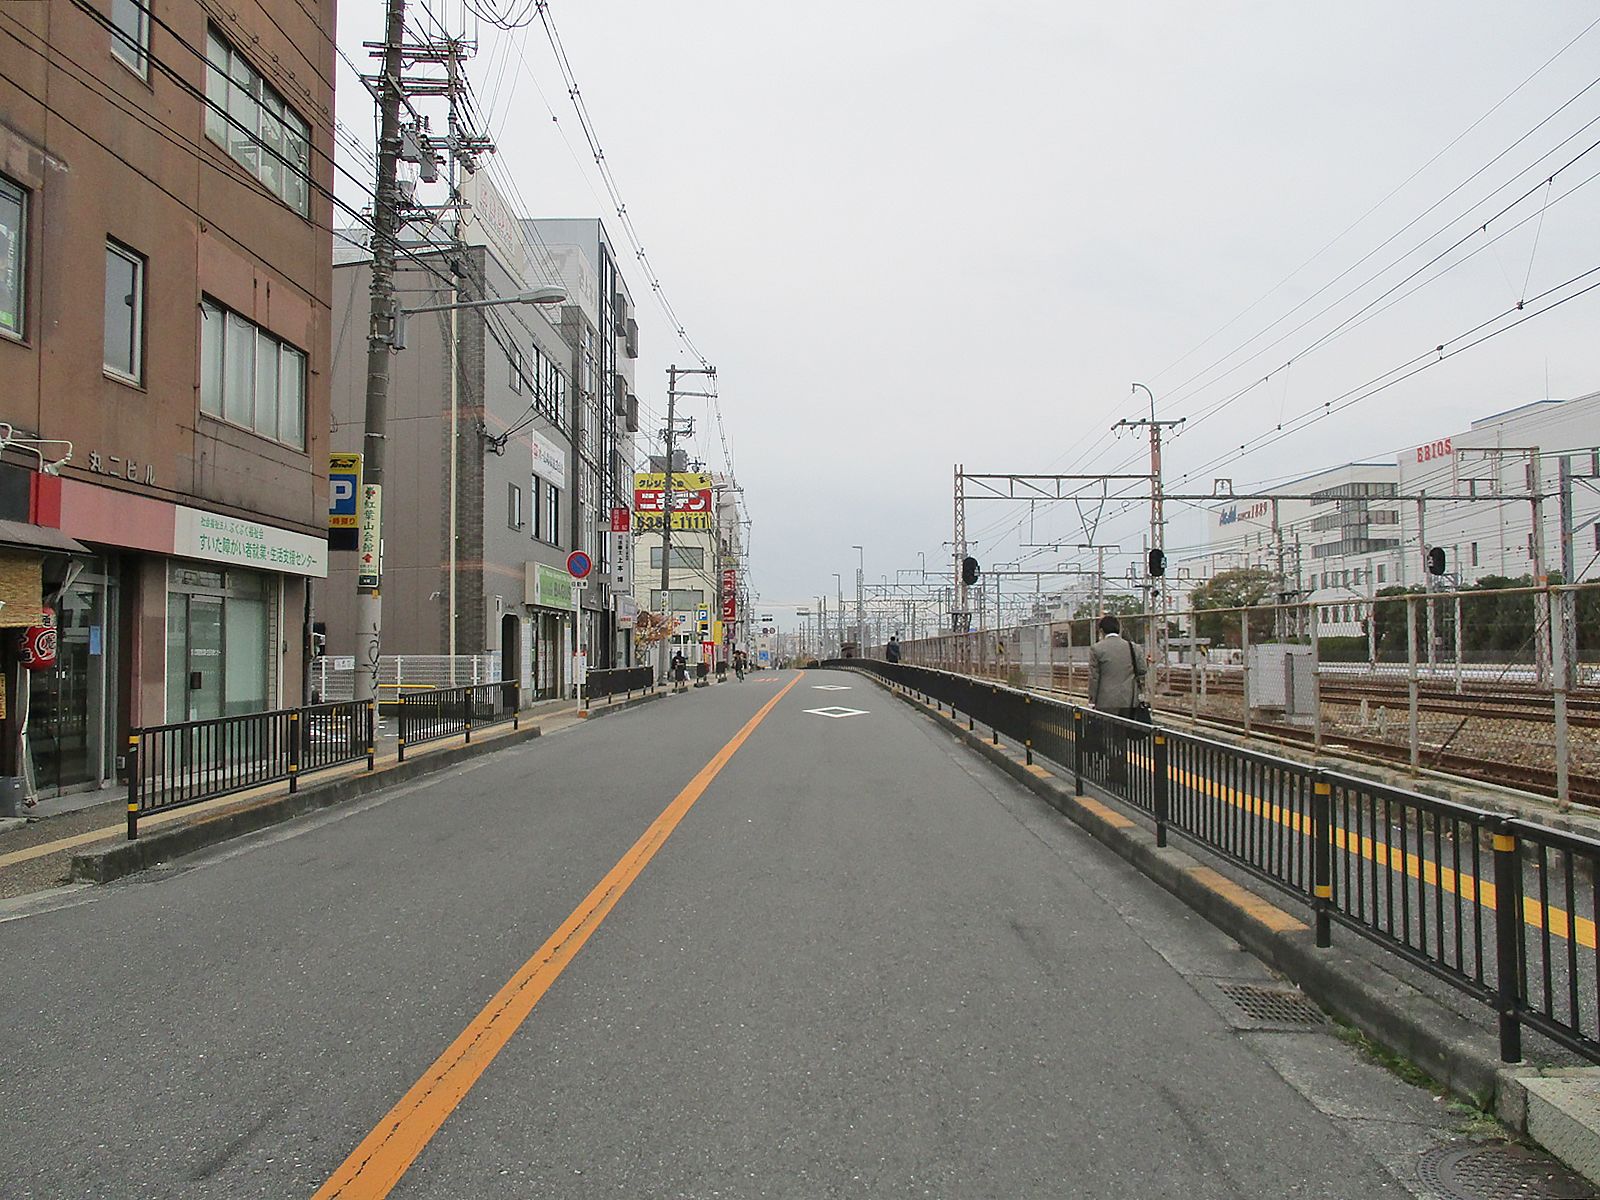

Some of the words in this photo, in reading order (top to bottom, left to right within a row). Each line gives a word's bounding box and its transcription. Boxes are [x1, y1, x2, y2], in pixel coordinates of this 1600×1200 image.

[1416, 439, 1452, 463] EBIOS
[90, 449, 156, 485] 丸二ビル
[329, 480, 353, 509] P
[329, 517, 356, 525] 時預り
[700, 611, 707, 619] P
